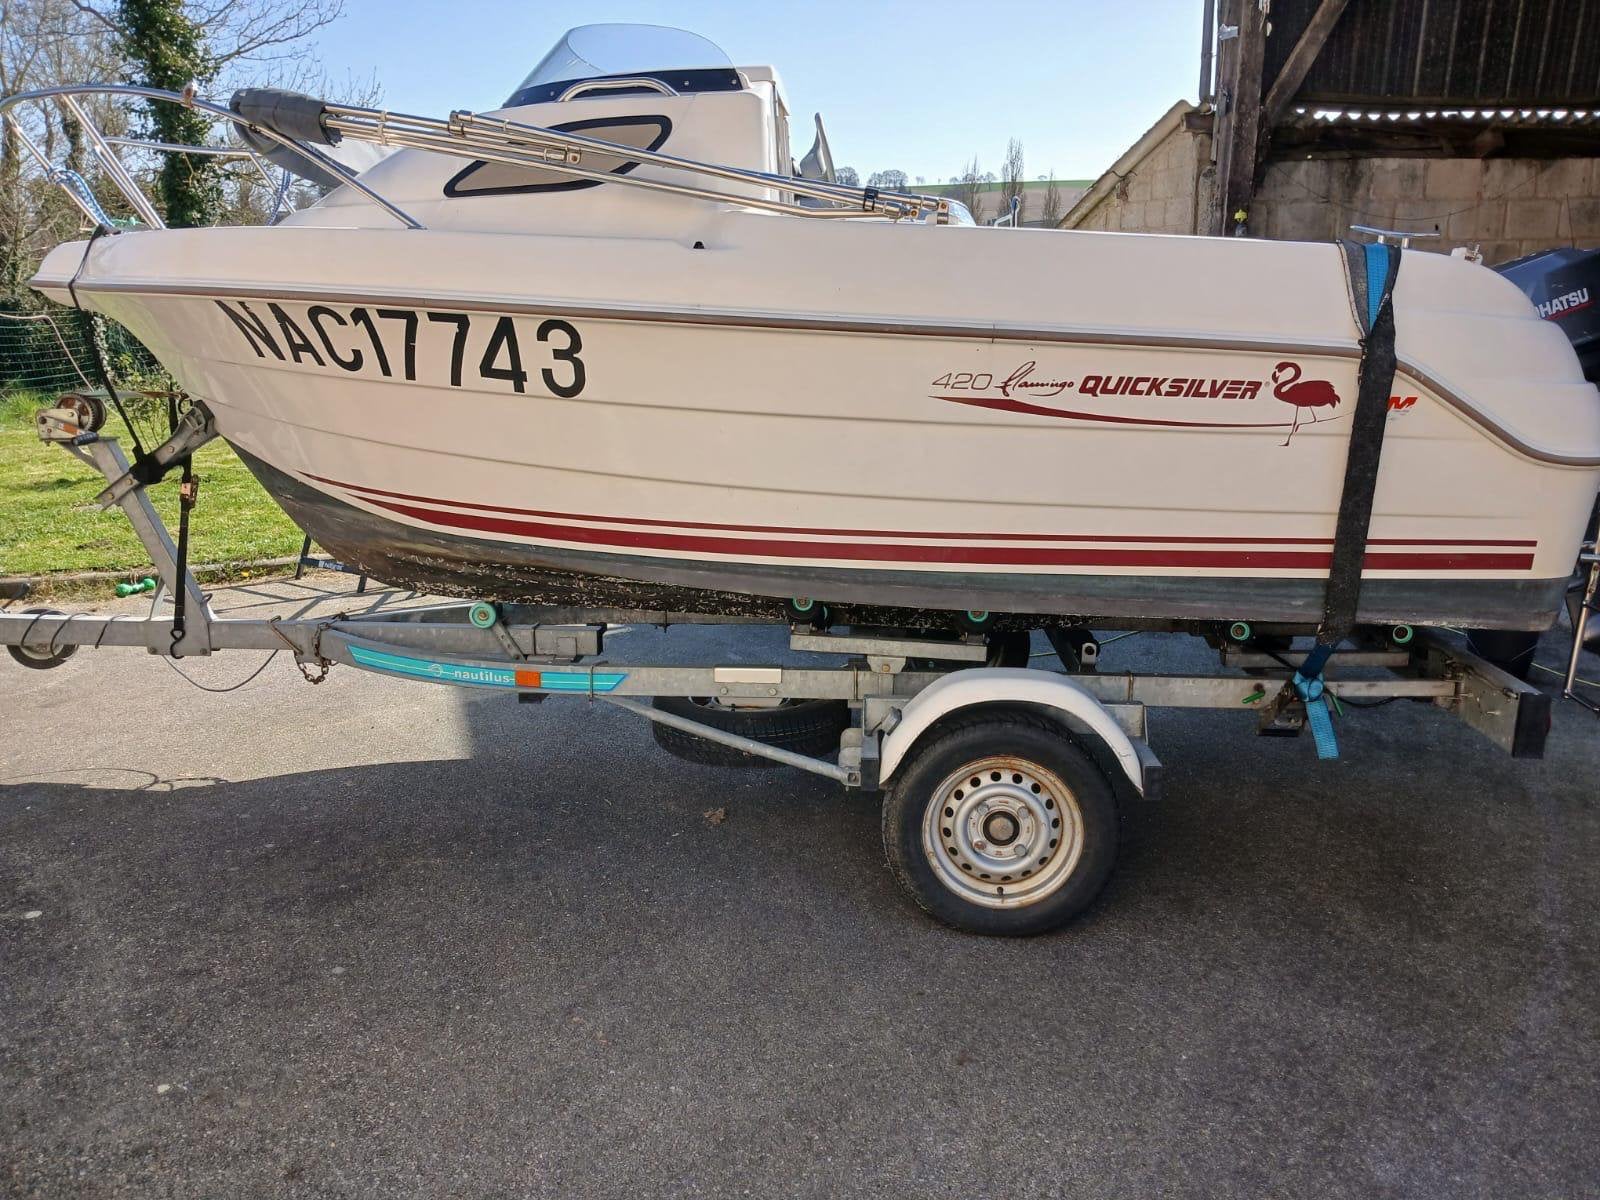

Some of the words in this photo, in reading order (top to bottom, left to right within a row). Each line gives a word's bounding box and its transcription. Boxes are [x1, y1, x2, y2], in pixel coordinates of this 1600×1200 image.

[214, 299, 586, 399] NAC17743
[931, 372, 994, 391] 420
[1078, 375, 1263, 400] QUICKSILVER
[454, 670, 510, 683] nautilus
